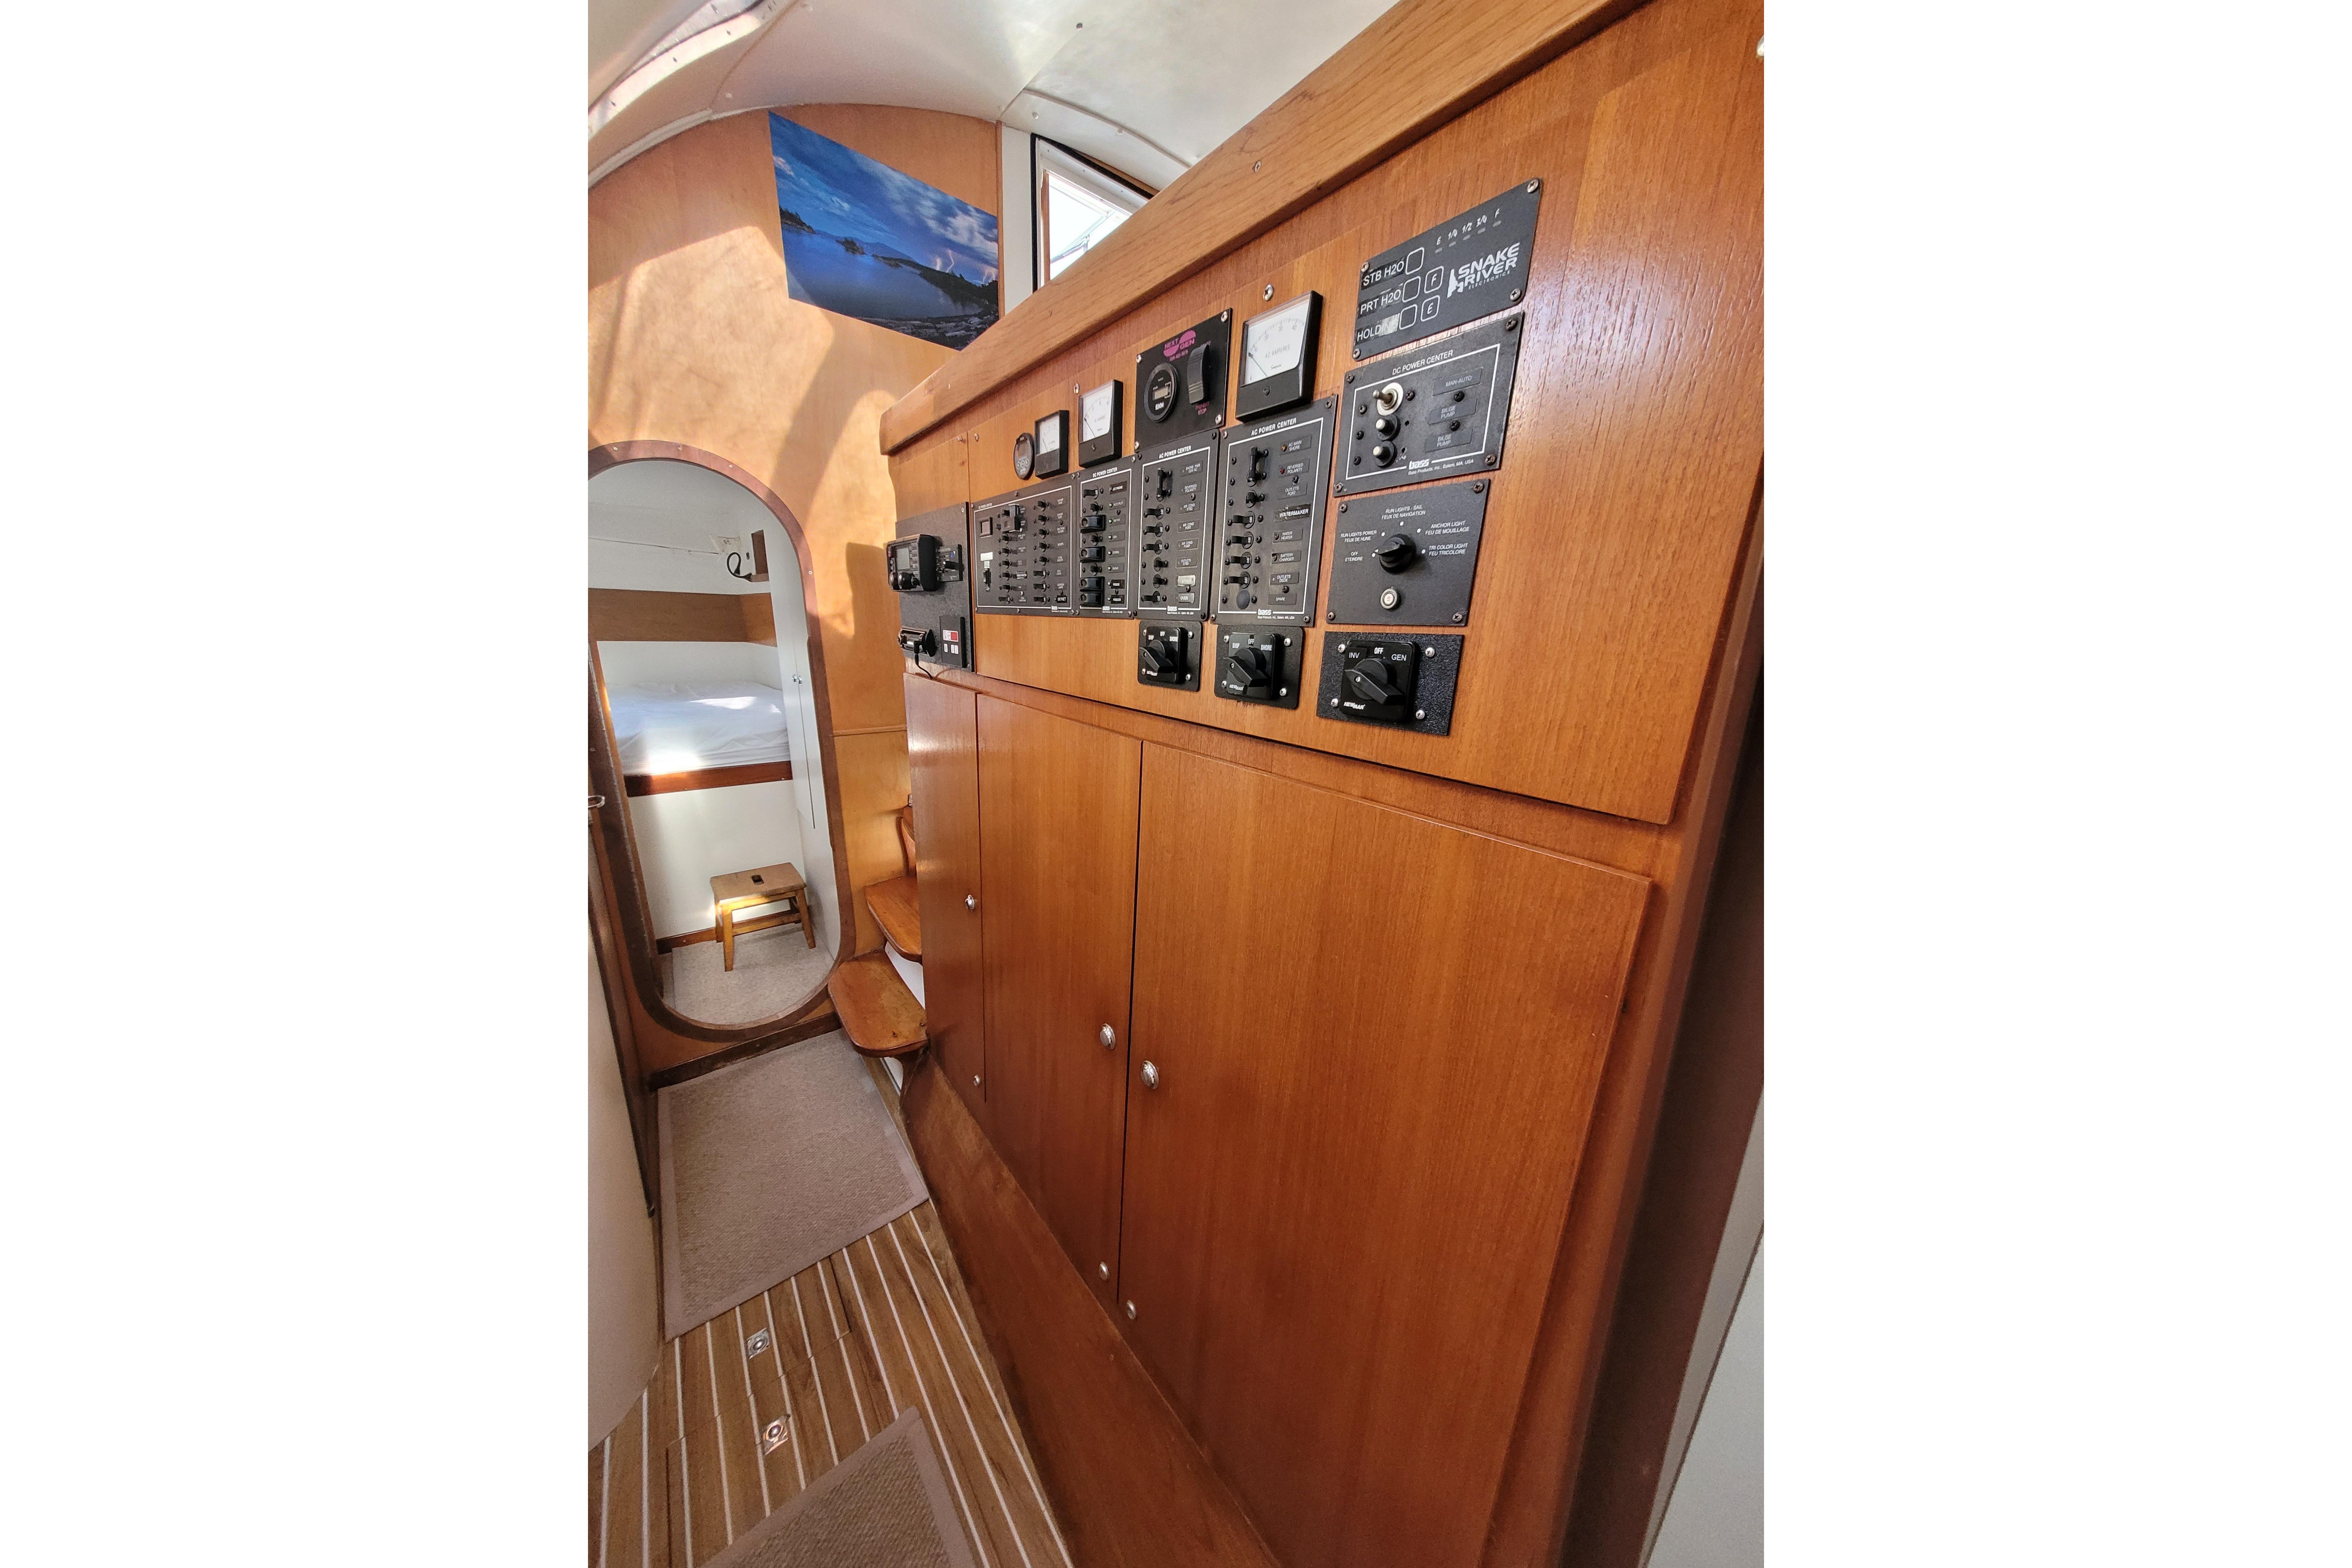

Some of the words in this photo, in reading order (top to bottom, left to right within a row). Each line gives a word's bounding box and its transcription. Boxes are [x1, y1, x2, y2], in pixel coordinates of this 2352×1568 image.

[1448, 229, 1457, 240] 1/4
[1462, 222, 1472, 233] 1/2
[1476, 215, 1487, 227] 3/4
[1495, 208, 1500, 218] F
[1458, 242, 1520, 279] SNAKE
[1363, 270, 1382, 286] STB
[1384, 261, 1405, 278] H2O
[1431, 273, 1437, 286] F
[1464, 257, 1517, 287] RIVER
[1468, 270, 1510, 290] ELECTRONICS
[1360, 298, 1379, 314] PRT
[1381, 289, 1401, 306] H2O
[1426, 304, 1433, 314] E
[1392, 367, 1401, 375] DC
[1402, 359, 1425, 372] POWER
[1426, 350, 1453, 364] CENTER
[1445, 376, 1472, 387] MAN-AUTO
[1259, 424, 1275, 434] POWER
[1277, 417, 1296, 428] CENTER
[1279, 508, 1308, 517] WATERMAKER
